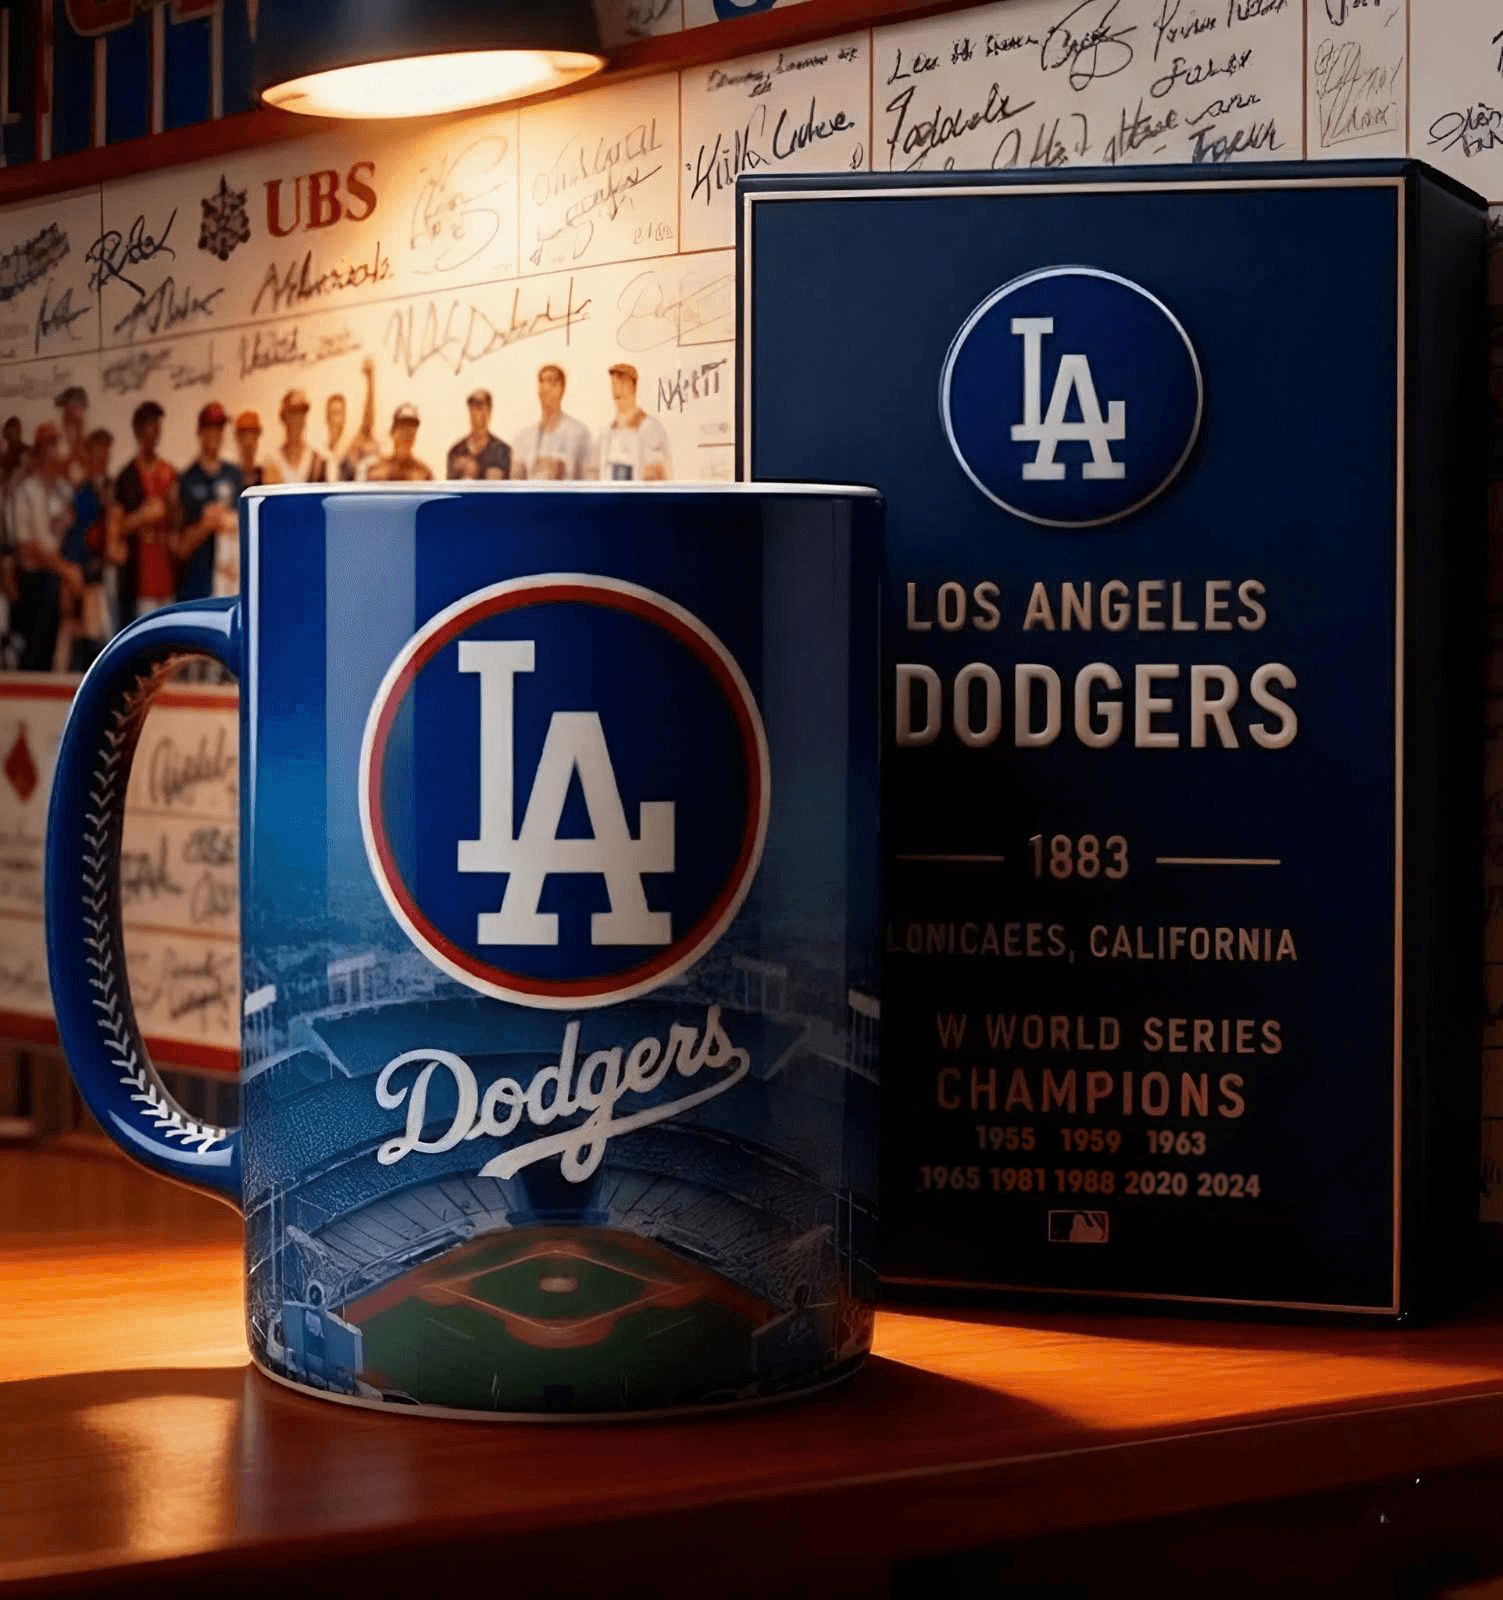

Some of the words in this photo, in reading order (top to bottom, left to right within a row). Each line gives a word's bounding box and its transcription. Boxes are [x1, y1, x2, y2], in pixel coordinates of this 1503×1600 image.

[264, 161, 378, 238] UBS
[1011, 316, 1126, 480] LA
[906, 580, 1001, 632] LOS
[1022, 579, 1267, 632] ANGELES
[895, 662, 1298, 750] DODGERS
[458, 640, 676, 946] LA
[1029, 834, 1129, 880] 1883
[1089, 924, 1298, 962] CALIFORNIA
[936, 1012, 967, 1050] W
[985, 1013, 1121, 1052] WORLD
[1143, 1016, 1283, 1055] SERIES
[375, 1003, 750, 1184] Dodgers
[936, 1066, 1246, 1119] CHAMPIONS
[975, 1125, 1036, 1152] 1955
[1061, 1127, 1122, 1154] 1959
[1146, 1130, 1207, 1156] 1963
[920, 1165, 981, 1191] 1965
[989, 1167, 1046, 1192] 1981
[1054, 1168, 1116, 1195] 1988
[1124, 1171, 1189, 1196] 2020
[1197, 1173, 1262, 1198] 2024
